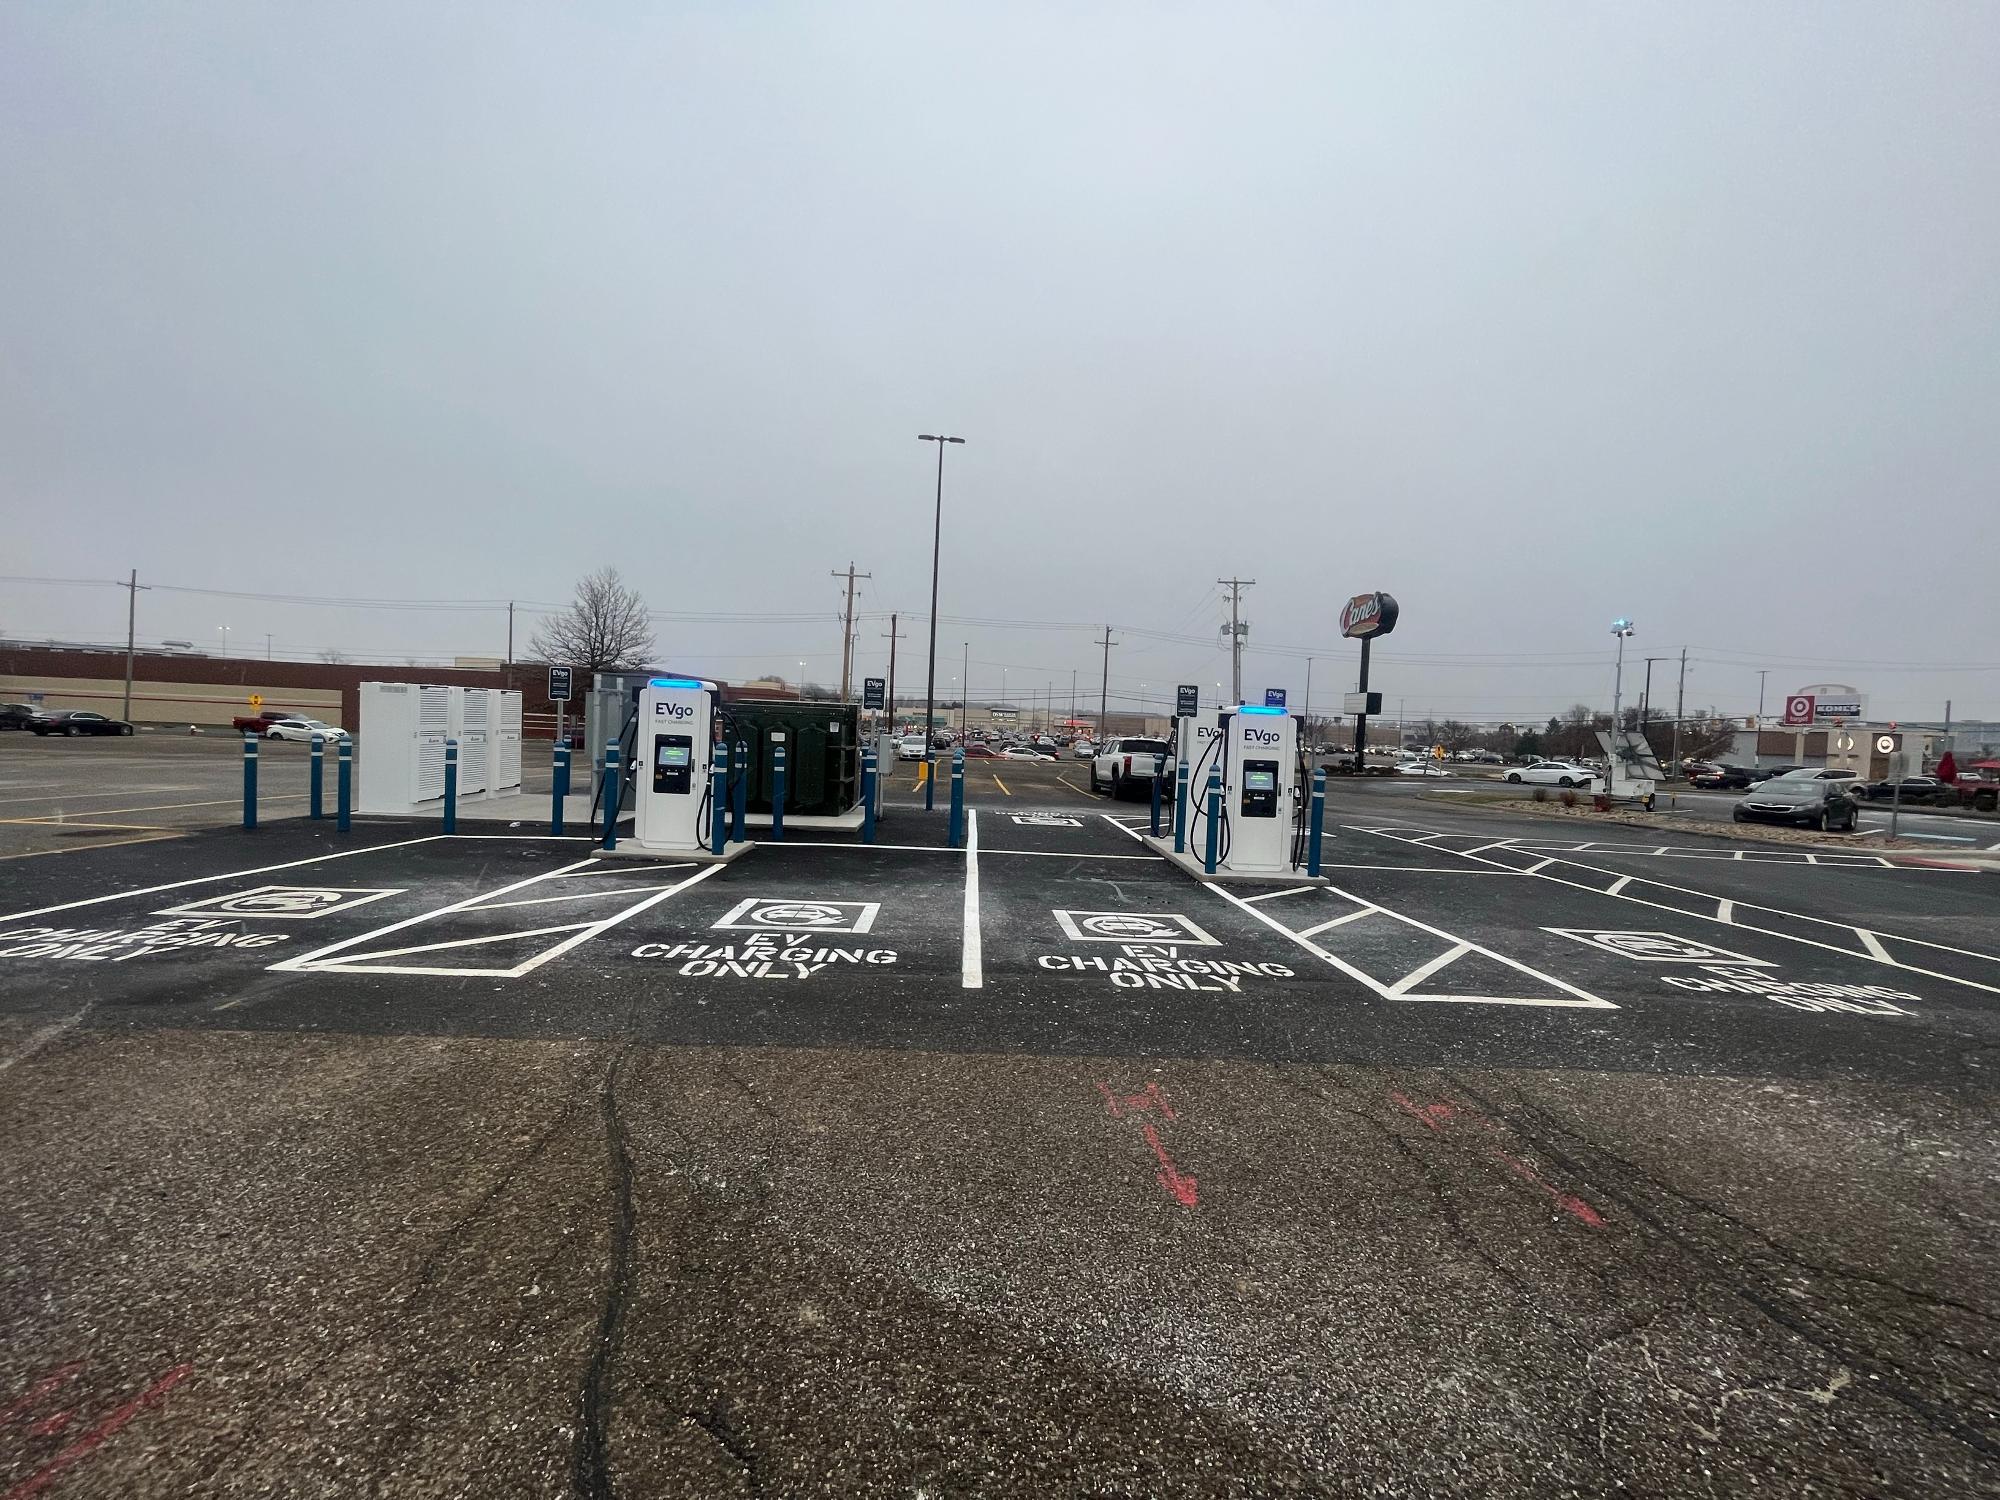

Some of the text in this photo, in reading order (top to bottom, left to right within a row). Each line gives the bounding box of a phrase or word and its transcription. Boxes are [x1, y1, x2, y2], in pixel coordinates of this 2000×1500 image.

[867, 680, 883, 688] EVgo
[1180, 687, 1196, 695] EVgo
[1268, 690, 1284, 698] EVgo
[656, 702, 694, 719] EVgo
[1244, 728, 1280, 745] EVgo
[744, 933, 812, 947] EV
[630, 943, 898, 964] CHARGING
[1120, 944, 1178, 959] EV
[678, 960, 828, 979] ONLY
[1038, 955, 1295, 977] CHARGING
[1109, 972, 1242, 992] ONLY
